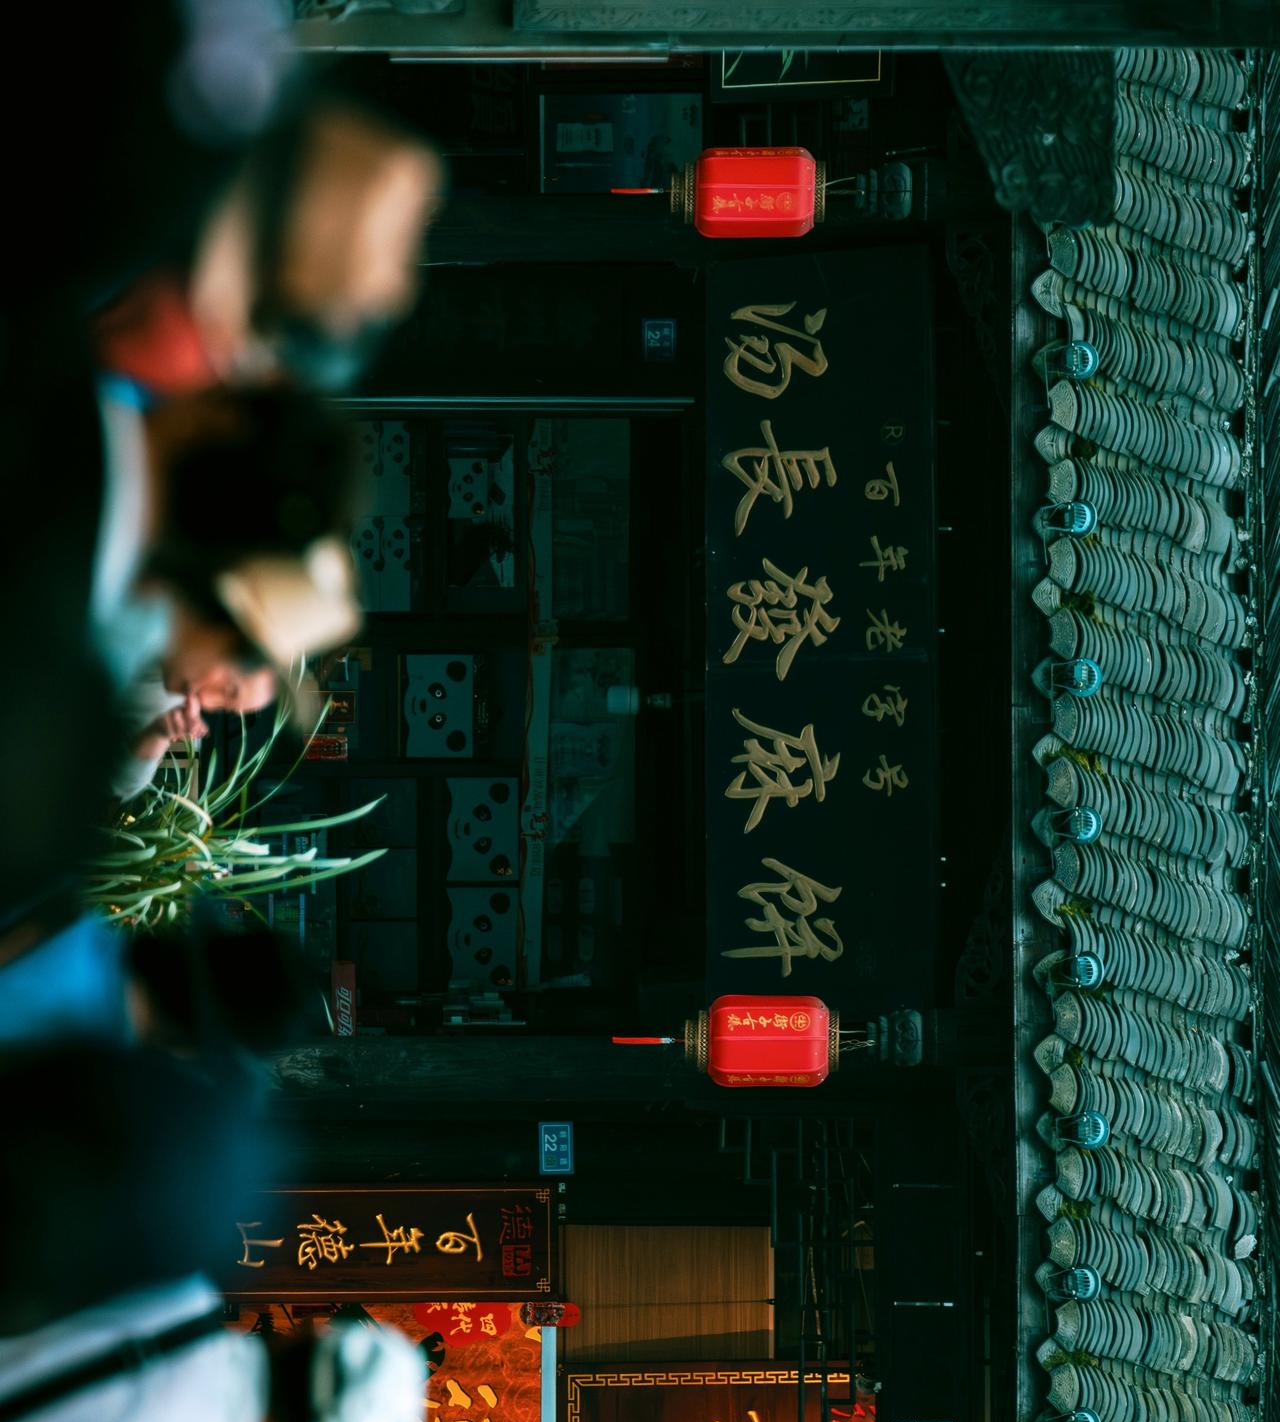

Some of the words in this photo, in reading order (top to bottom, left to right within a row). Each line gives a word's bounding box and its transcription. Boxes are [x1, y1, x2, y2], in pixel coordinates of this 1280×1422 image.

[859, 460, 910, 798] 百年老字号
[544, 1133, 557, 1152] 22
[235, 1213, 484, 1270] 百年德山
